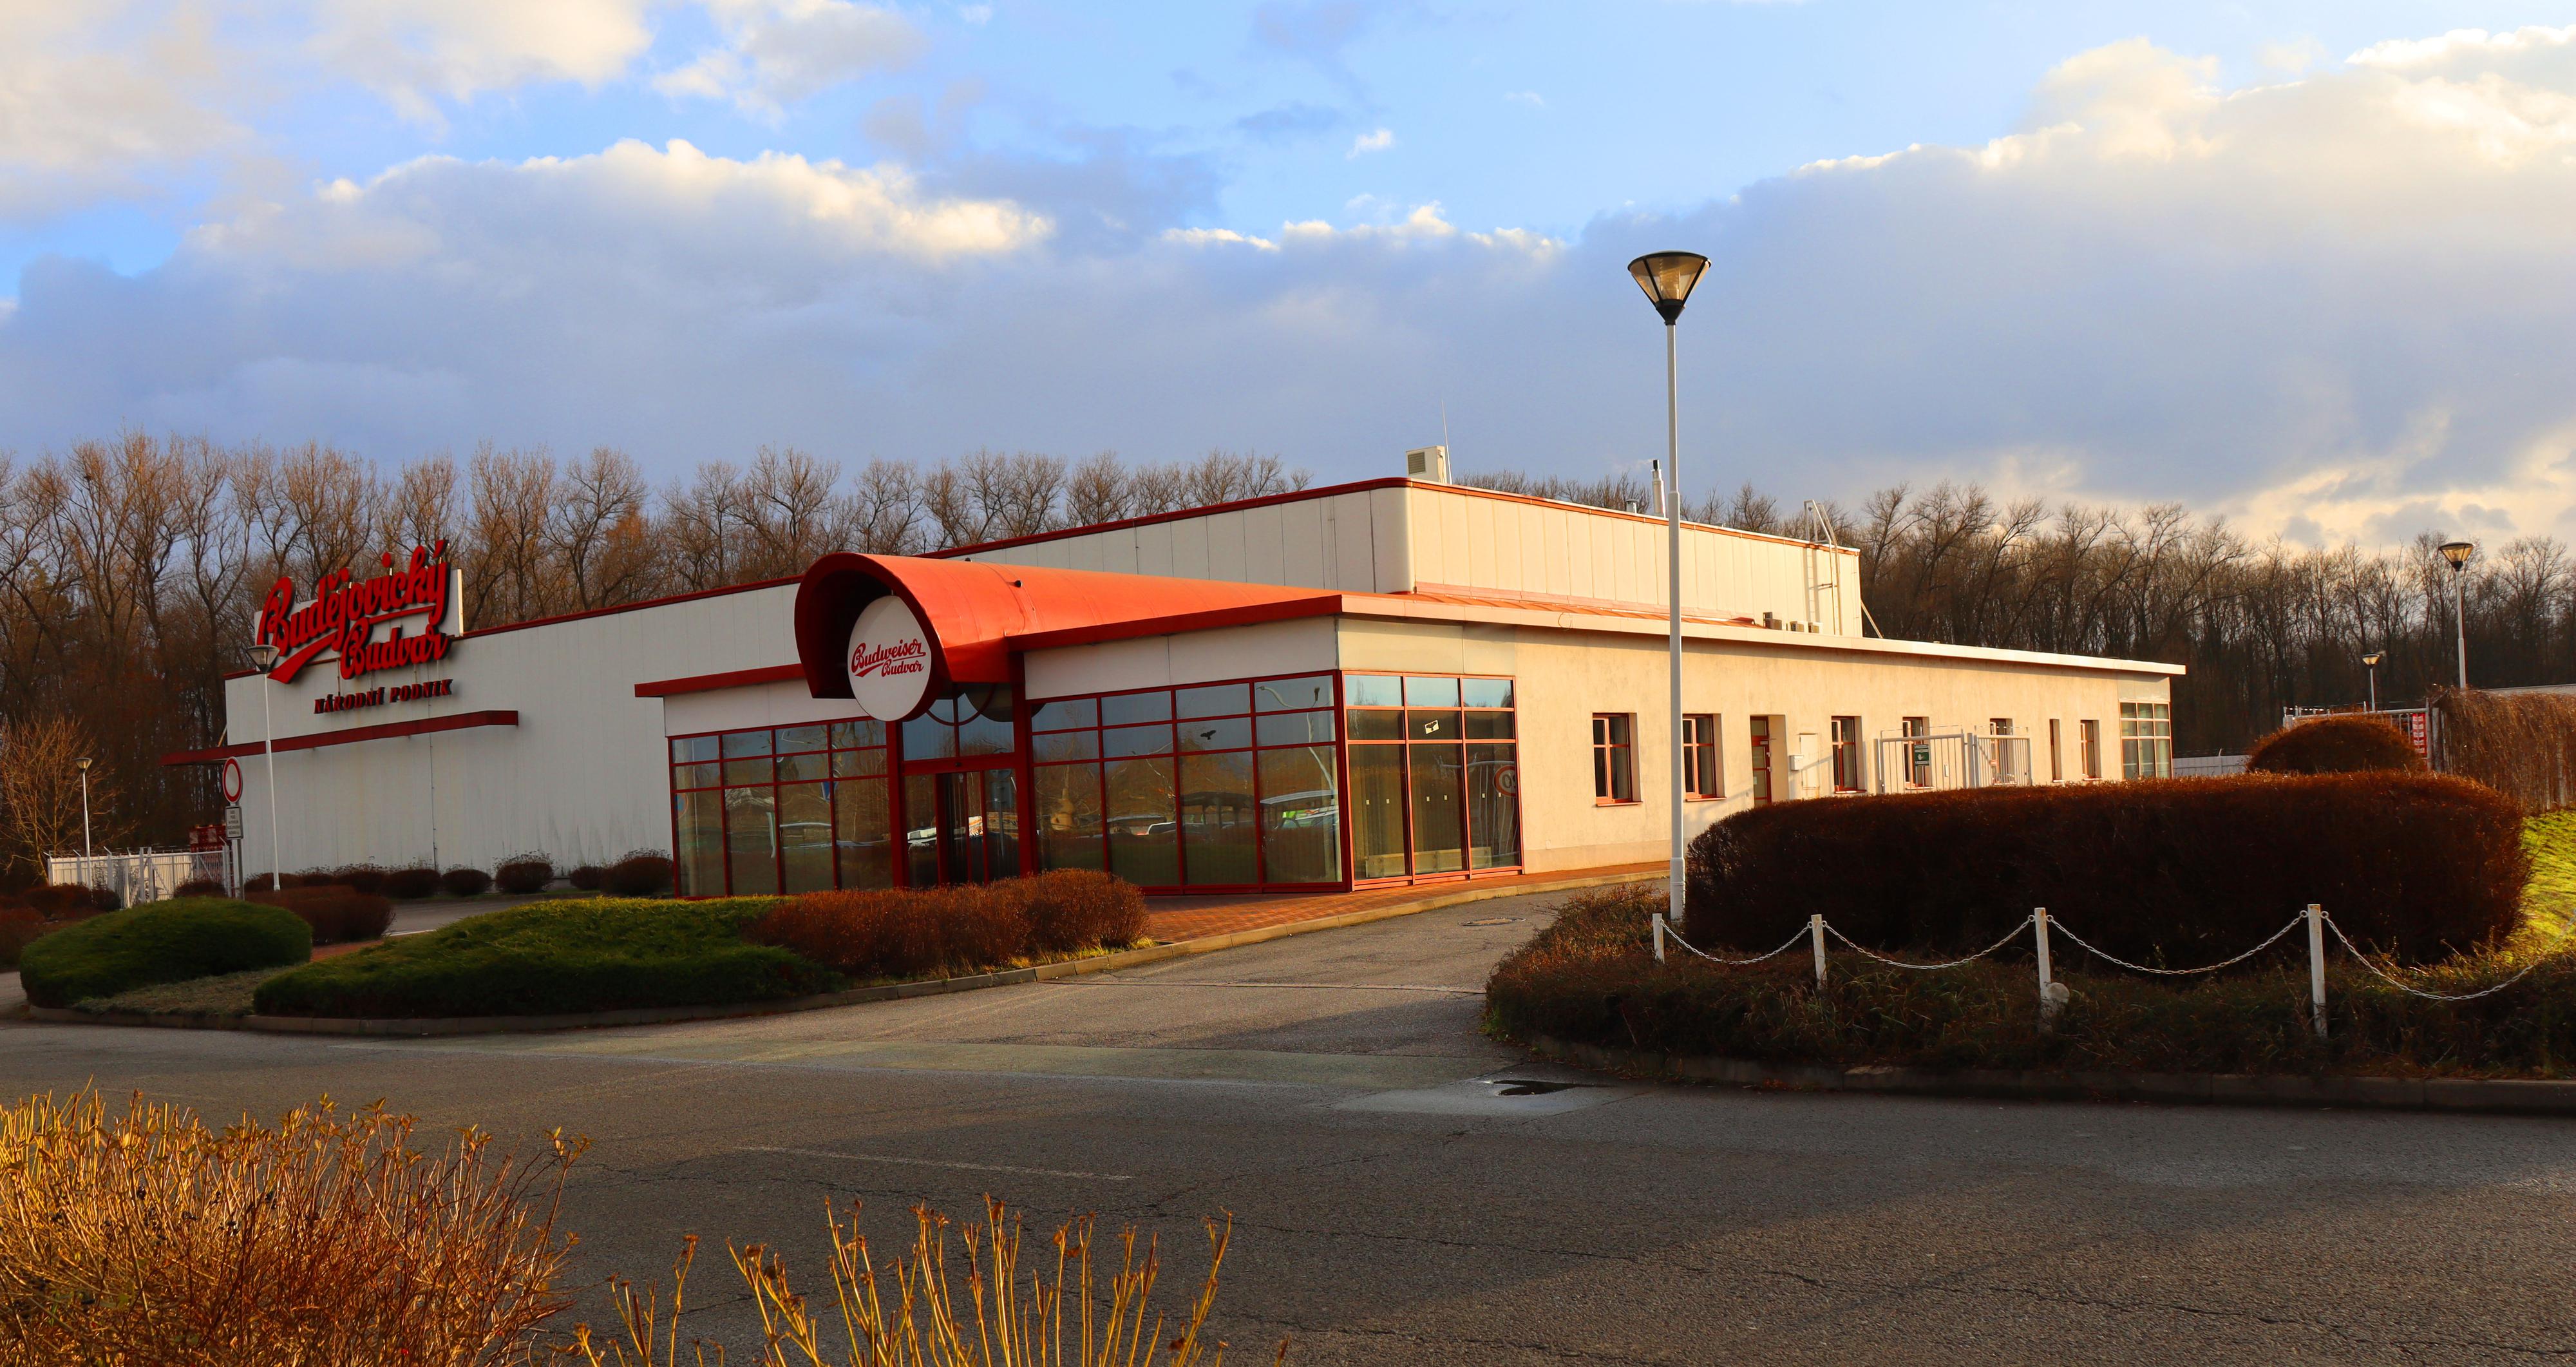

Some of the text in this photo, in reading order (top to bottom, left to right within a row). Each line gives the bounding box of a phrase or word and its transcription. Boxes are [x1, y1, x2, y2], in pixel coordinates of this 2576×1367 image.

[256, 540, 450, 656] Budějovický
[340, 617, 448, 680] Budvar
[851, 638, 926, 673] Budweiser
[881, 659, 924, 677] Budvar
[314, 679, 453, 714] NÁRODNÍ PODNIK
